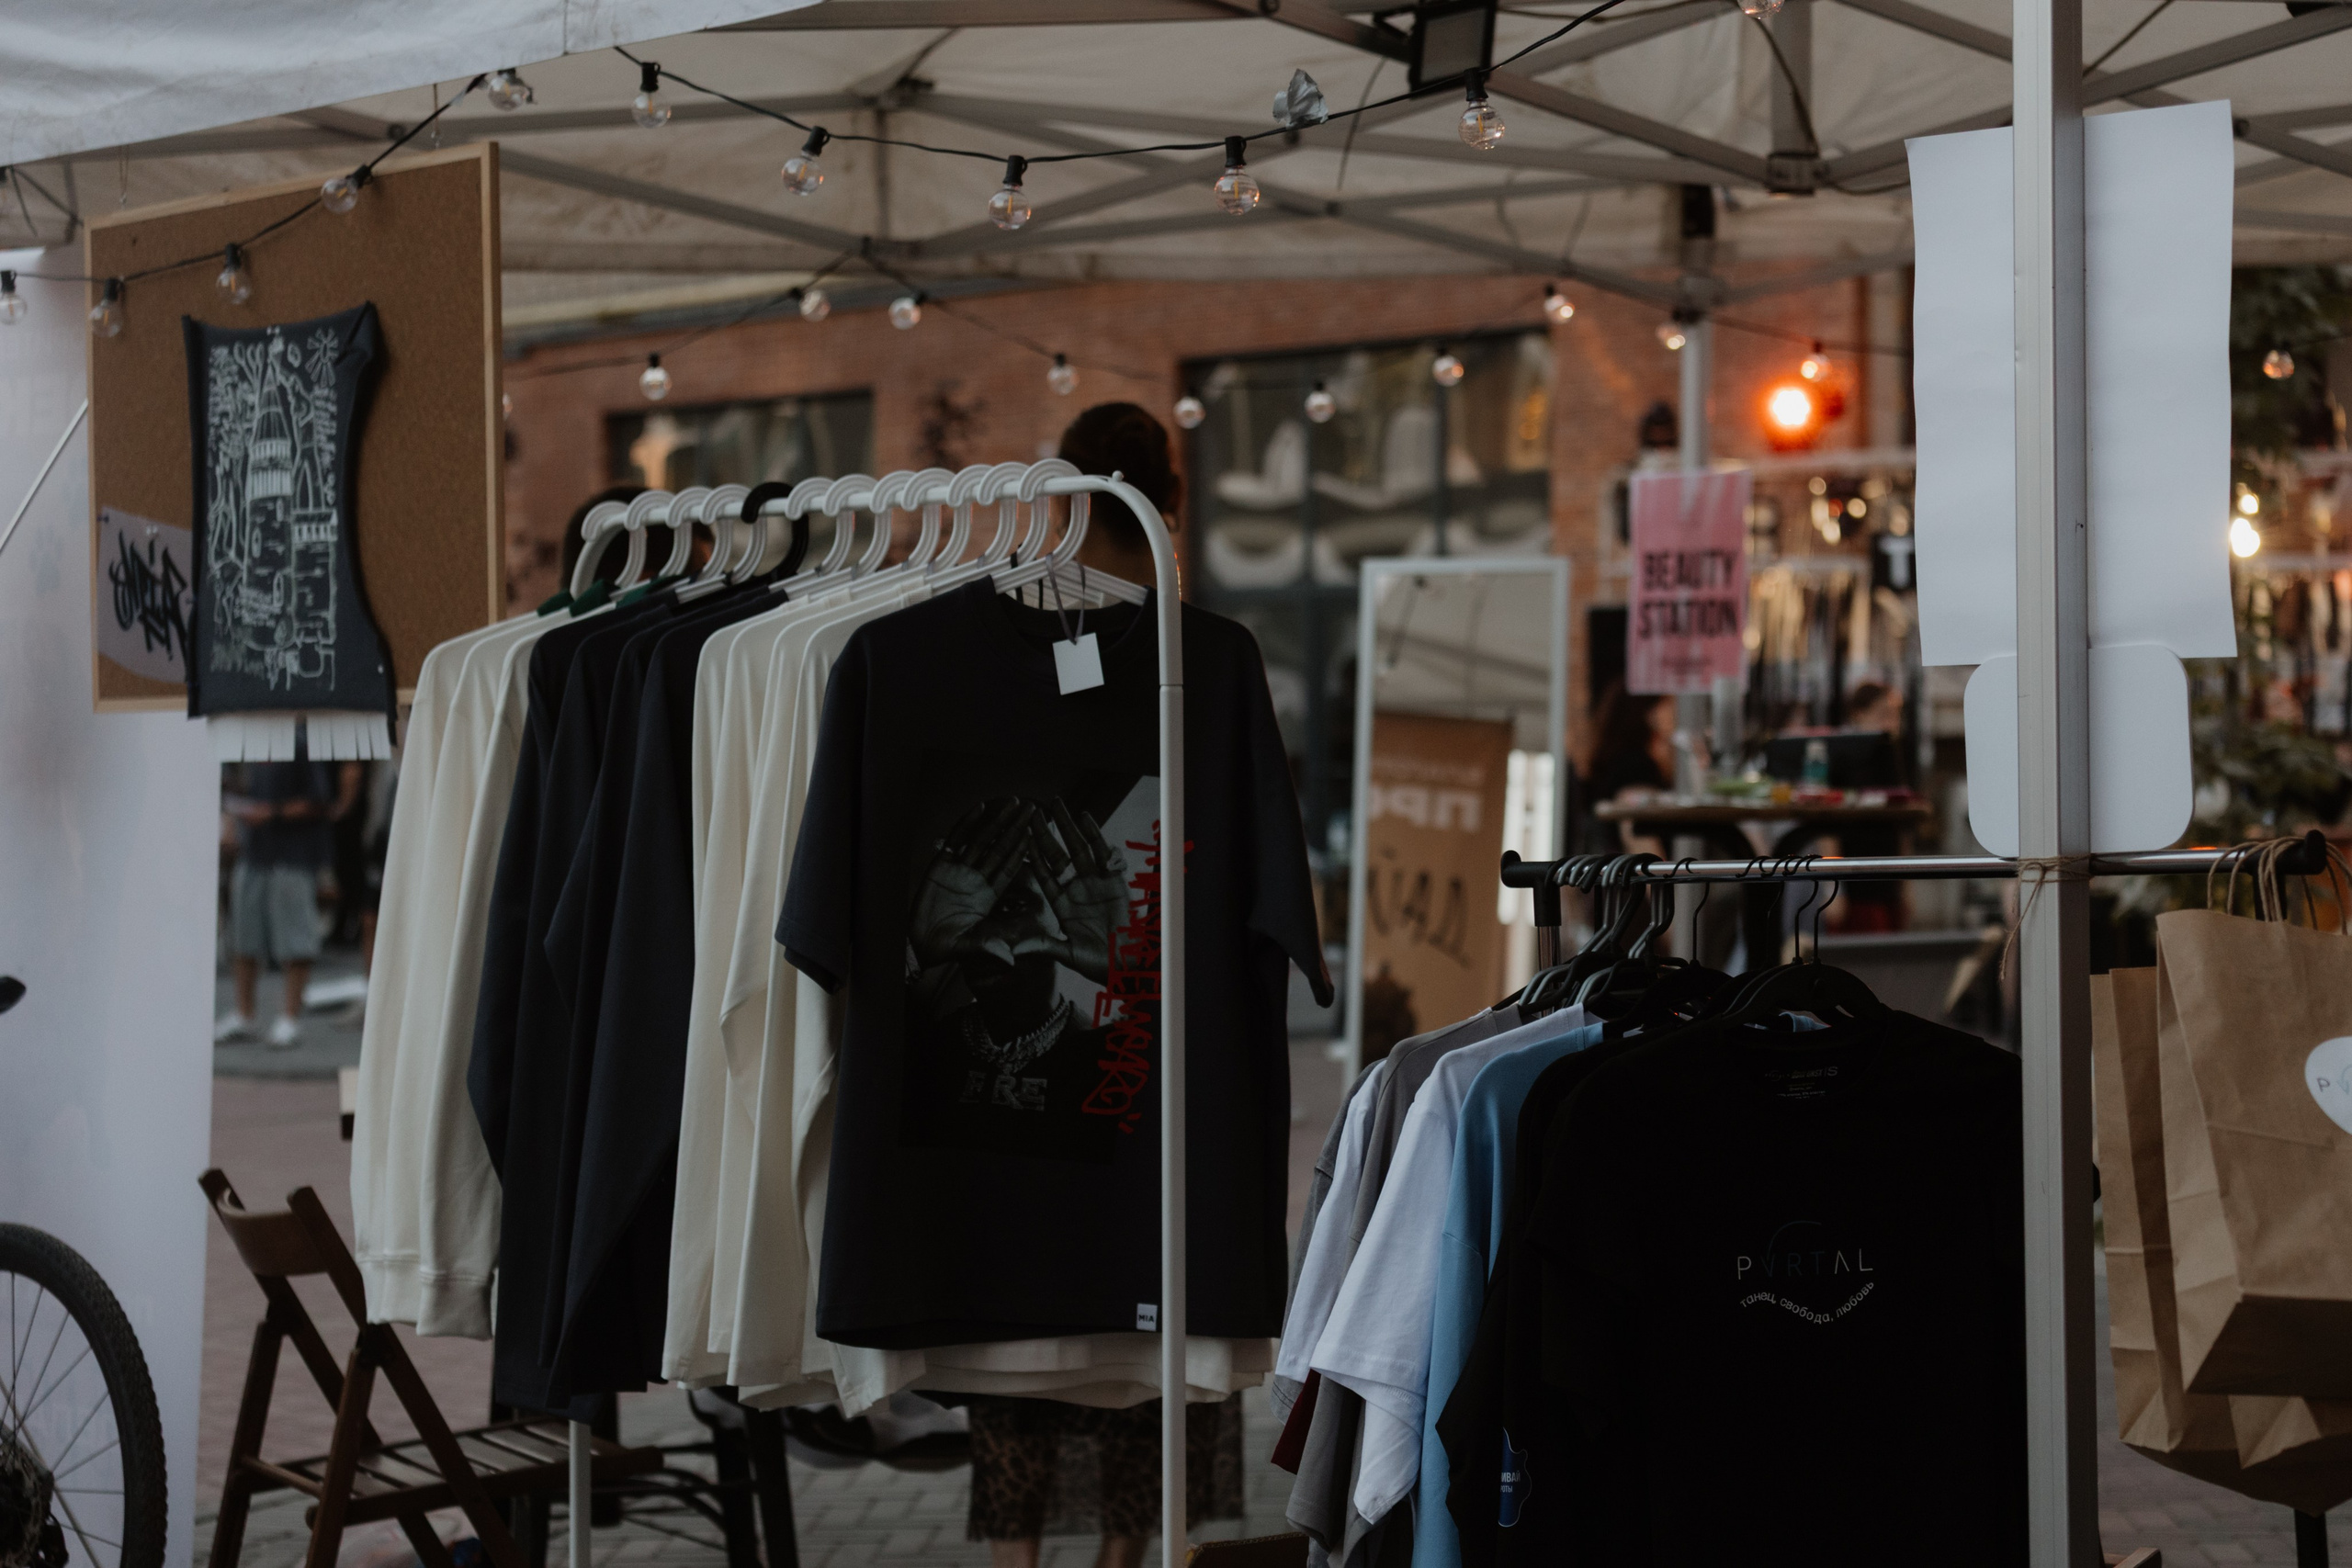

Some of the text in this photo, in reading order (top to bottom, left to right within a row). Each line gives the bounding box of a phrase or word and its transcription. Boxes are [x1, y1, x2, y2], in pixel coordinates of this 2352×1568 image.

[1644, 551, 1736, 590] BEAUTY
[1639, 597, 1737, 638] STATION
[1780, 1297, 1834, 1324] свобода,
[1836, 1282, 1874, 1318] любовь
